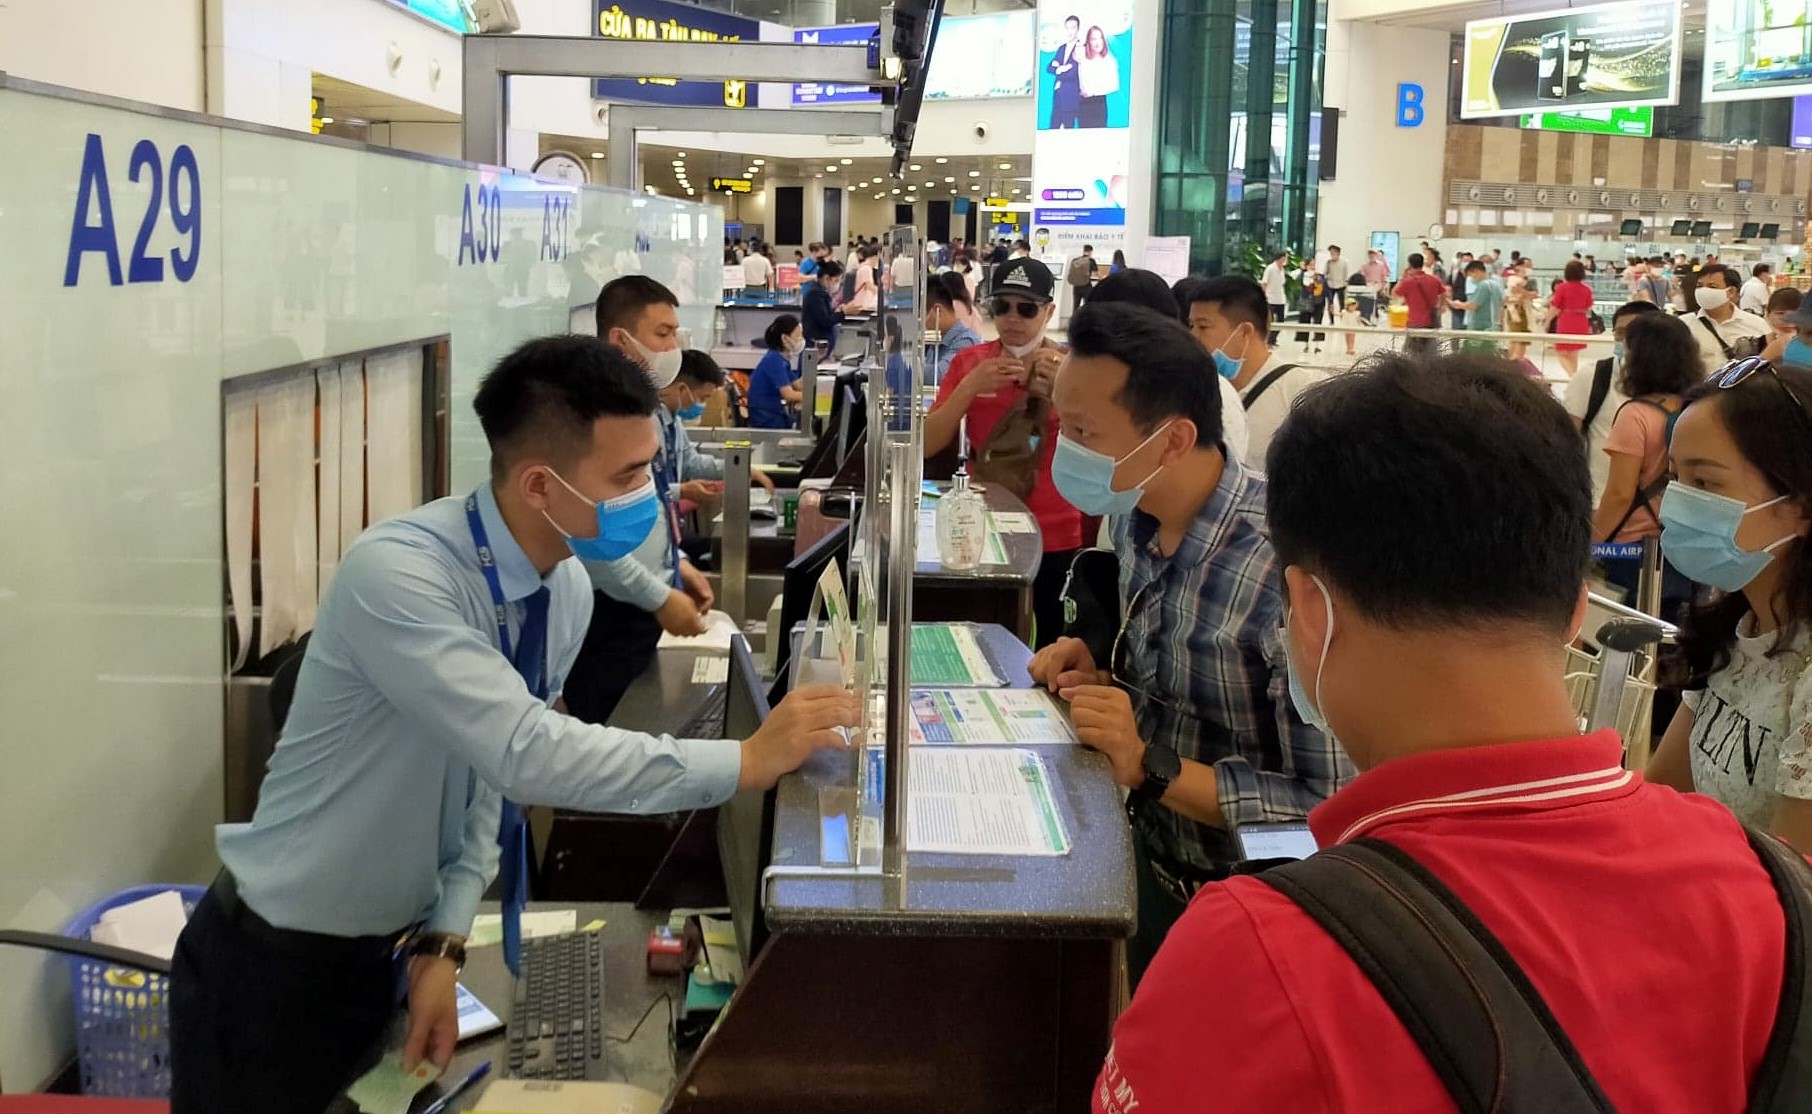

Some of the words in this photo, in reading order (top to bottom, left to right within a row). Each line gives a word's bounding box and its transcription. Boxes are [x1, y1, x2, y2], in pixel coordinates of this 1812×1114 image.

[600, 5, 633, 39] CỬA
[635, 17, 657, 40] RA
[660, 19, 689, 42] TÀU
[1396, 83, 1424, 127] B
[63, 133, 201, 287] A29
[458, 183, 501, 266] A30
[540, 193, 568, 262] A31
[1620, 546, 1643, 556] AIRP
